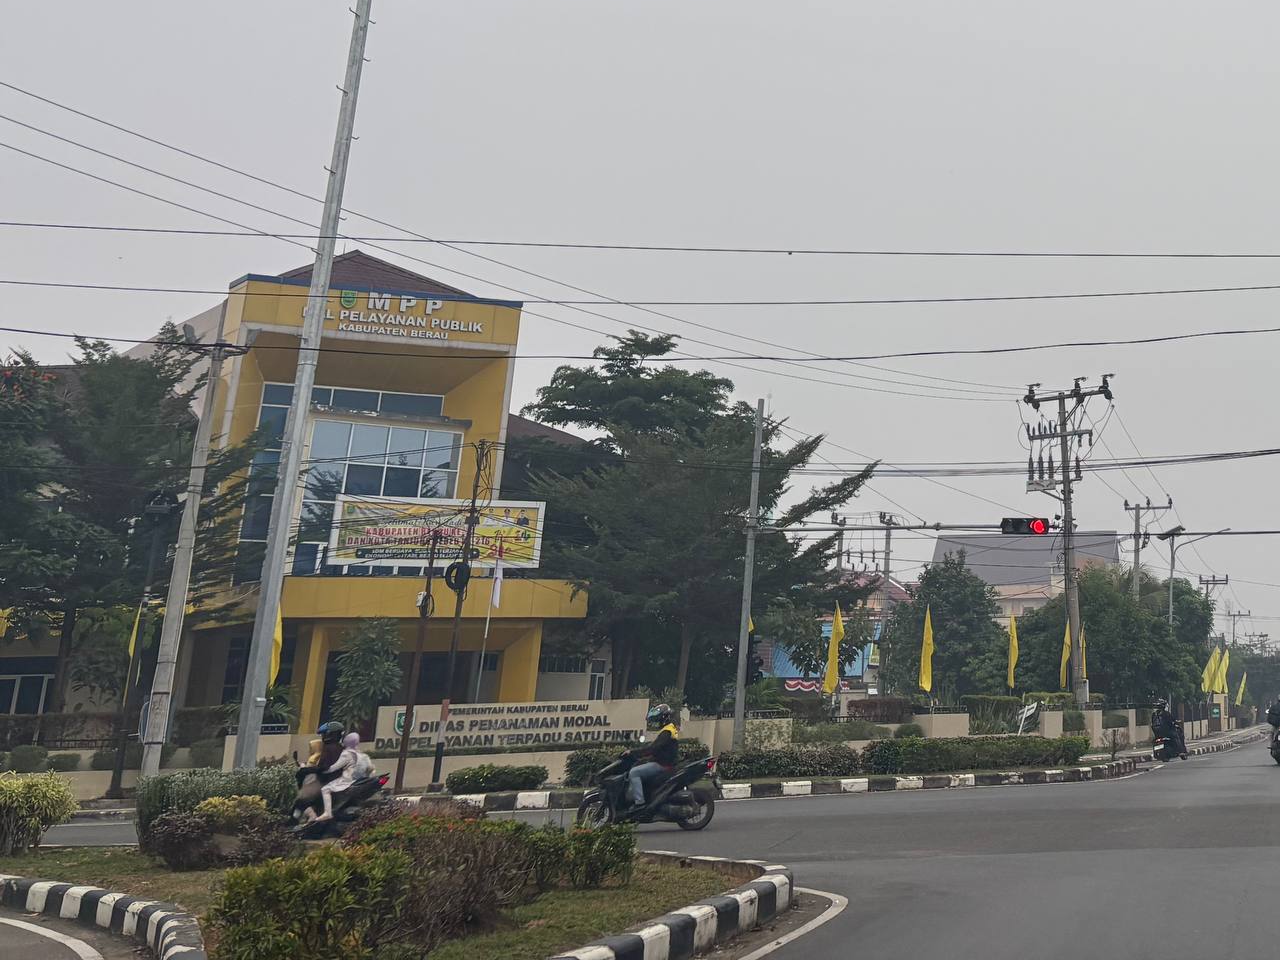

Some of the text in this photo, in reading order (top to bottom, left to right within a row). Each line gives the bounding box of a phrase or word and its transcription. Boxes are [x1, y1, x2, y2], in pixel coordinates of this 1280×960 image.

[339, 309, 427, 328] PELAYANAN
[431, 318, 484, 333] PUBLIK
[338, 322, 449, 340] KABUPATEN BERAU
[366, 527, 419, 536] KABUPATEN
[506, 705, 559, 715] KABUPATEN
[560, 704, 589, 713] BERAU
[468, 717, 561, 732] PENANAMAN
[563, 715, 611, 728] MODAL
[408, 734, 494, 749] PELYANAN
[497, 731, 562, 745] TERPADU
[563, 730, 601, 742] SATU
